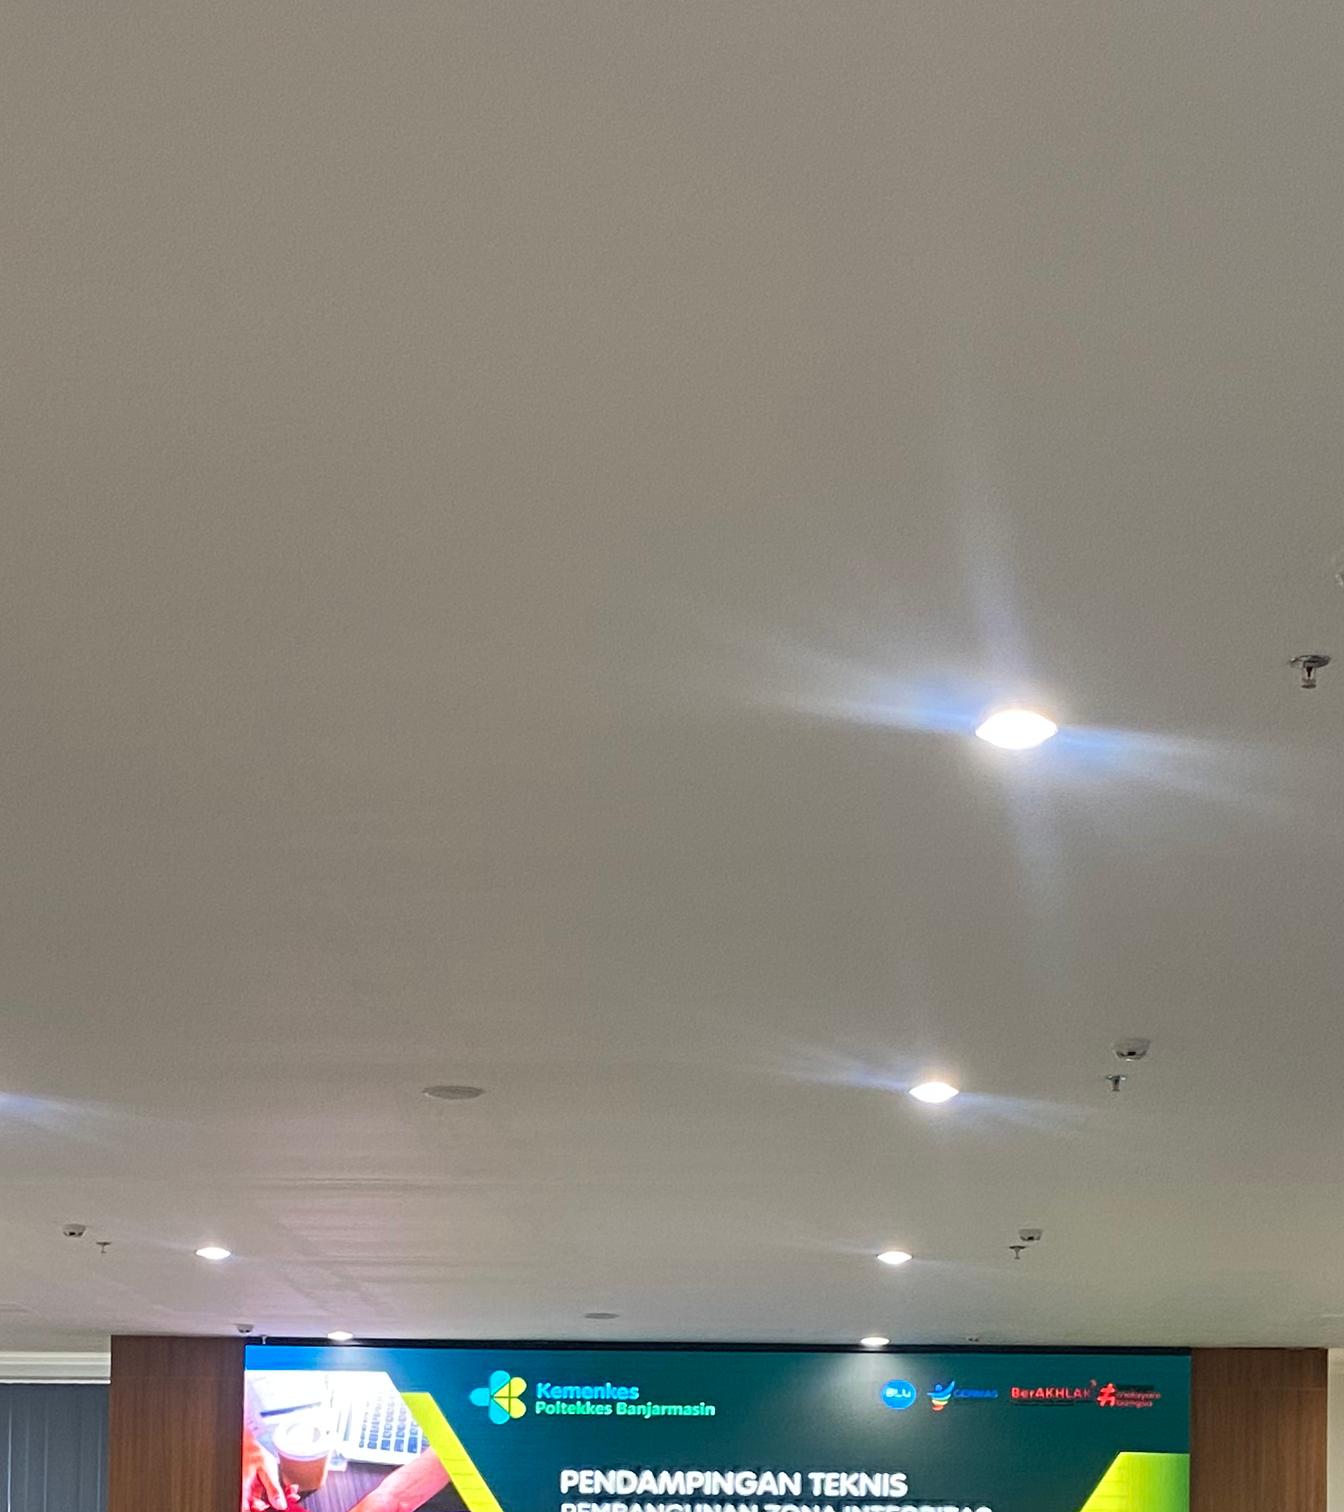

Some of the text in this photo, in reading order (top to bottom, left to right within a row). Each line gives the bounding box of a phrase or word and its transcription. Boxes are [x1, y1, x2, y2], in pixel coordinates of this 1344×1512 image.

[536, 1382, 639, 1400] Kemenkes
[535, 1401, 716, 1419] Poltekkes Banjarmasin
[560, 1469, 908, 1498] PENDAMPINGAN TEKNIS
